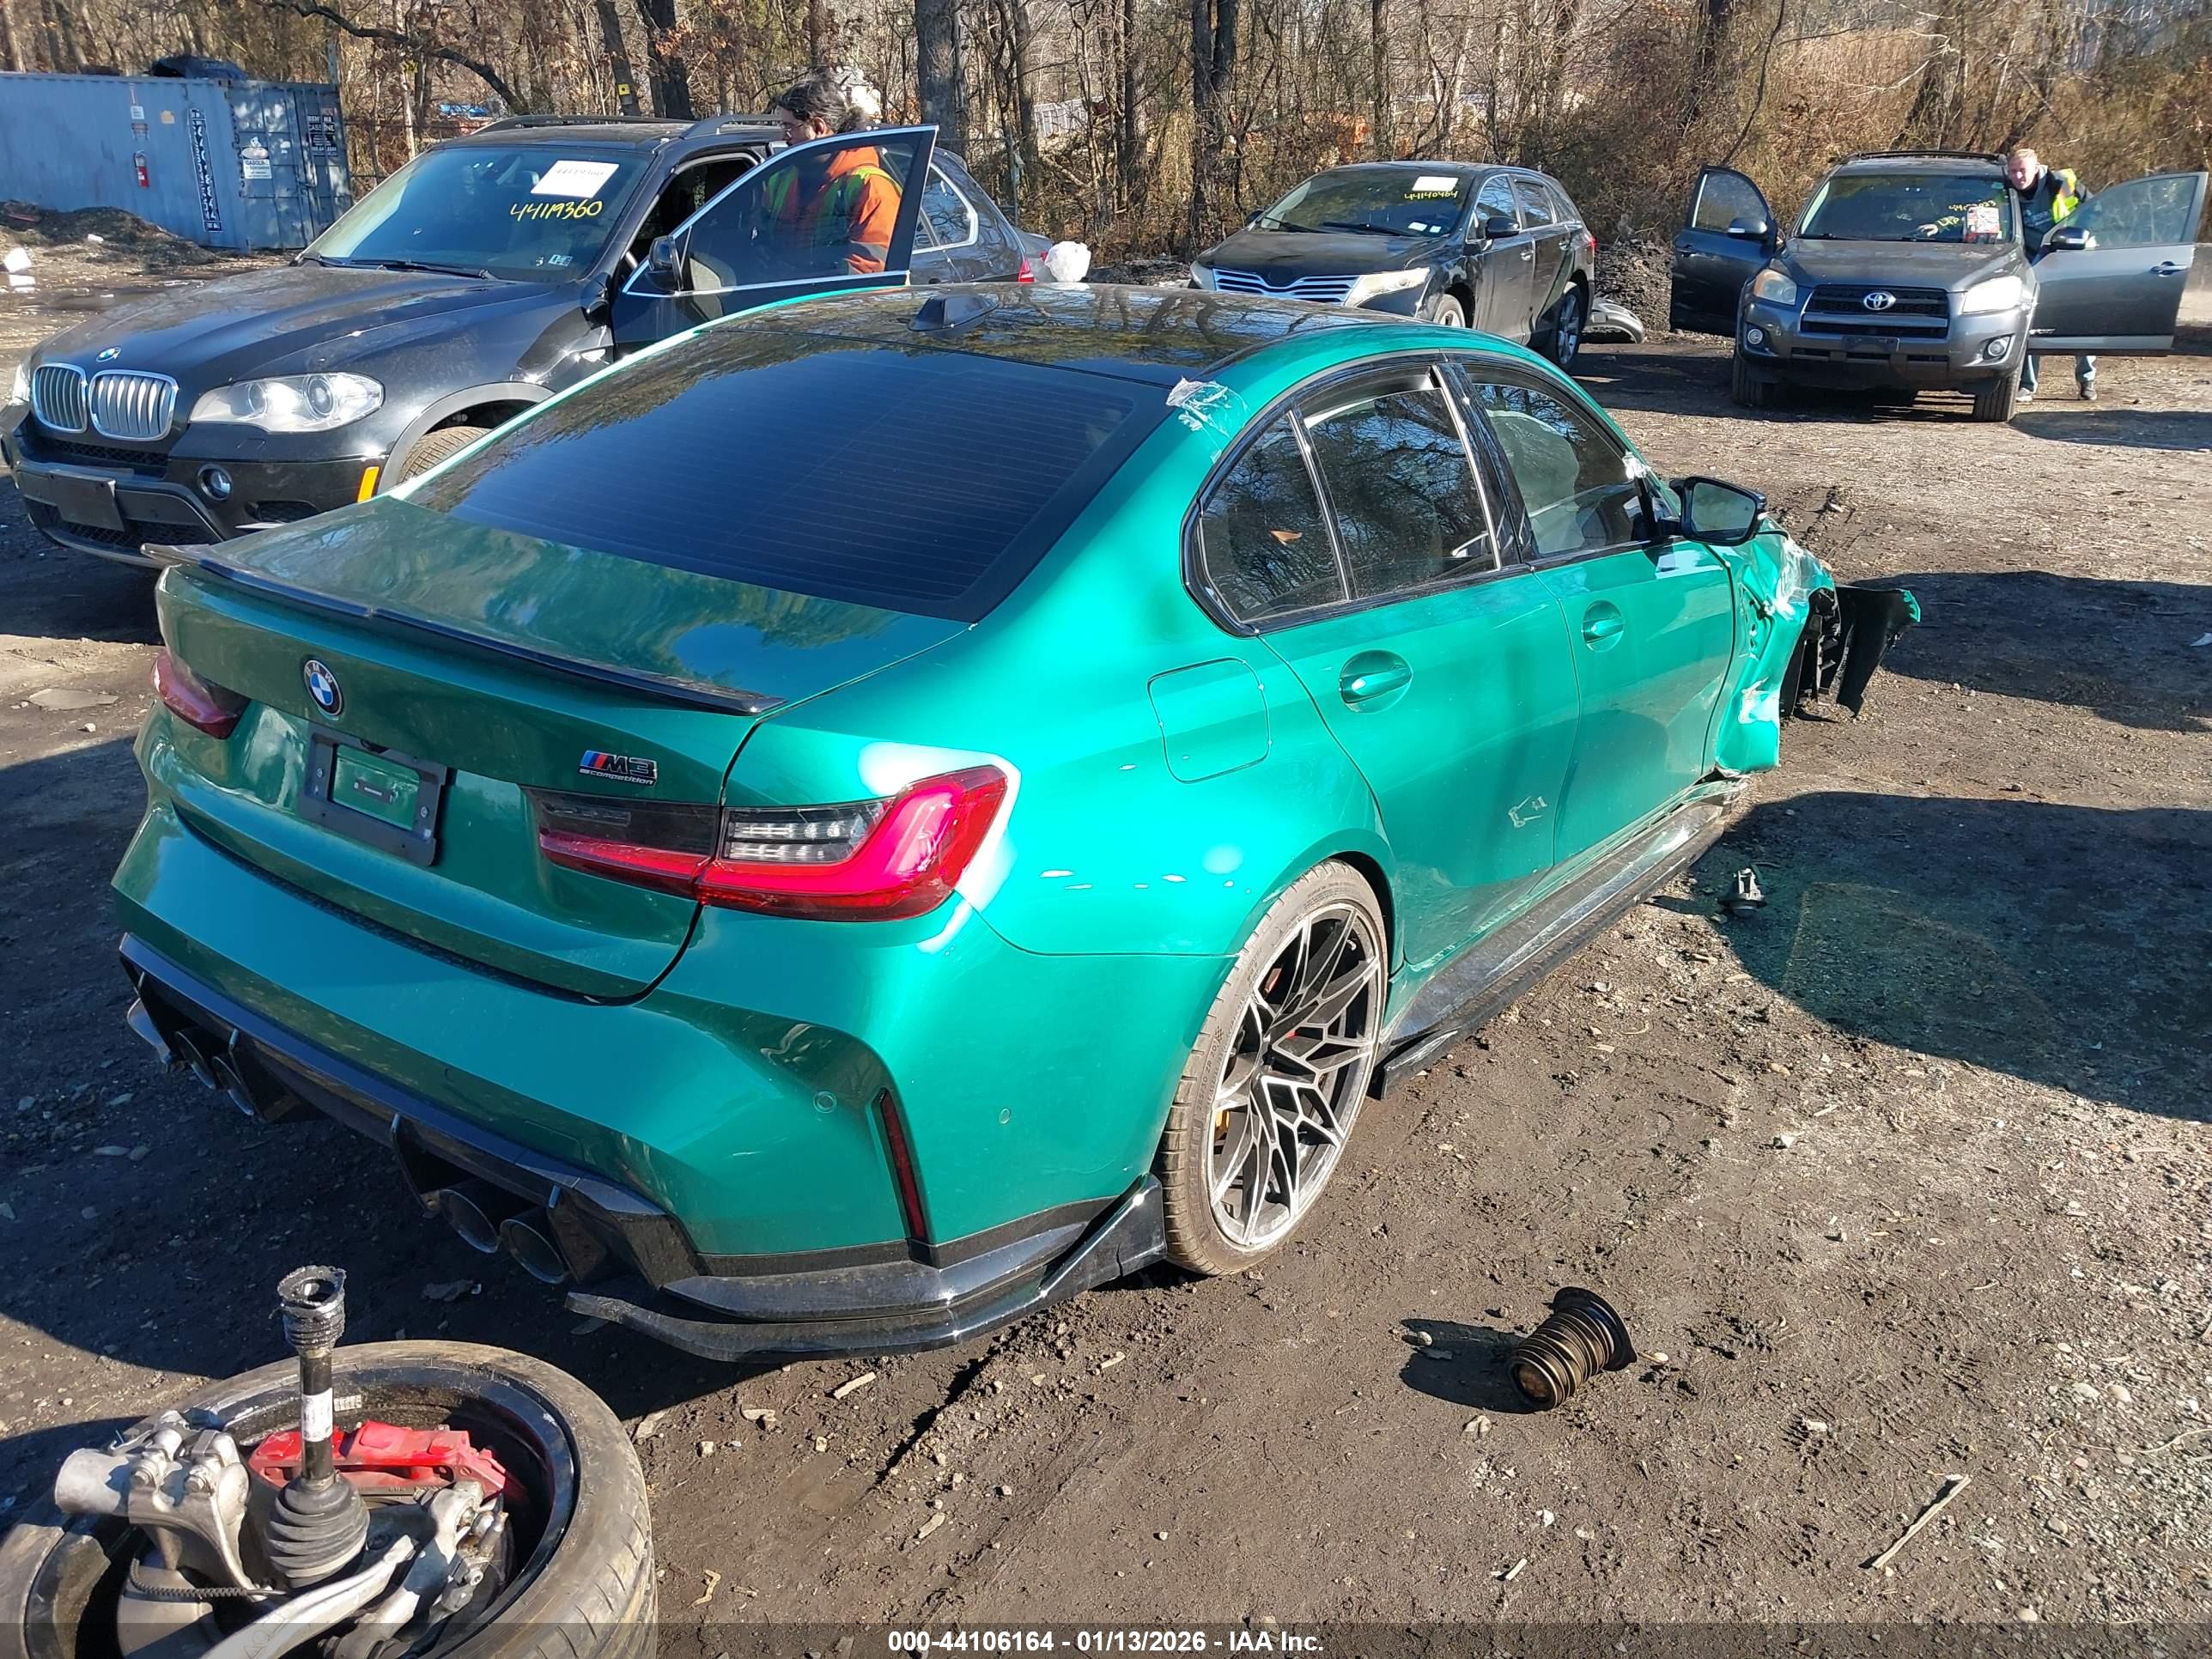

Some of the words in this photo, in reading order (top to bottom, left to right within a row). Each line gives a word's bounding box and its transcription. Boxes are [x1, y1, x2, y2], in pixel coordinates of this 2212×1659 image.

[510, 198, 603, 222] 44119360
[305, 662, 333, 684] BMW
[596, 751, 658, 779] M3
[588, 769, 653, 785] competition
